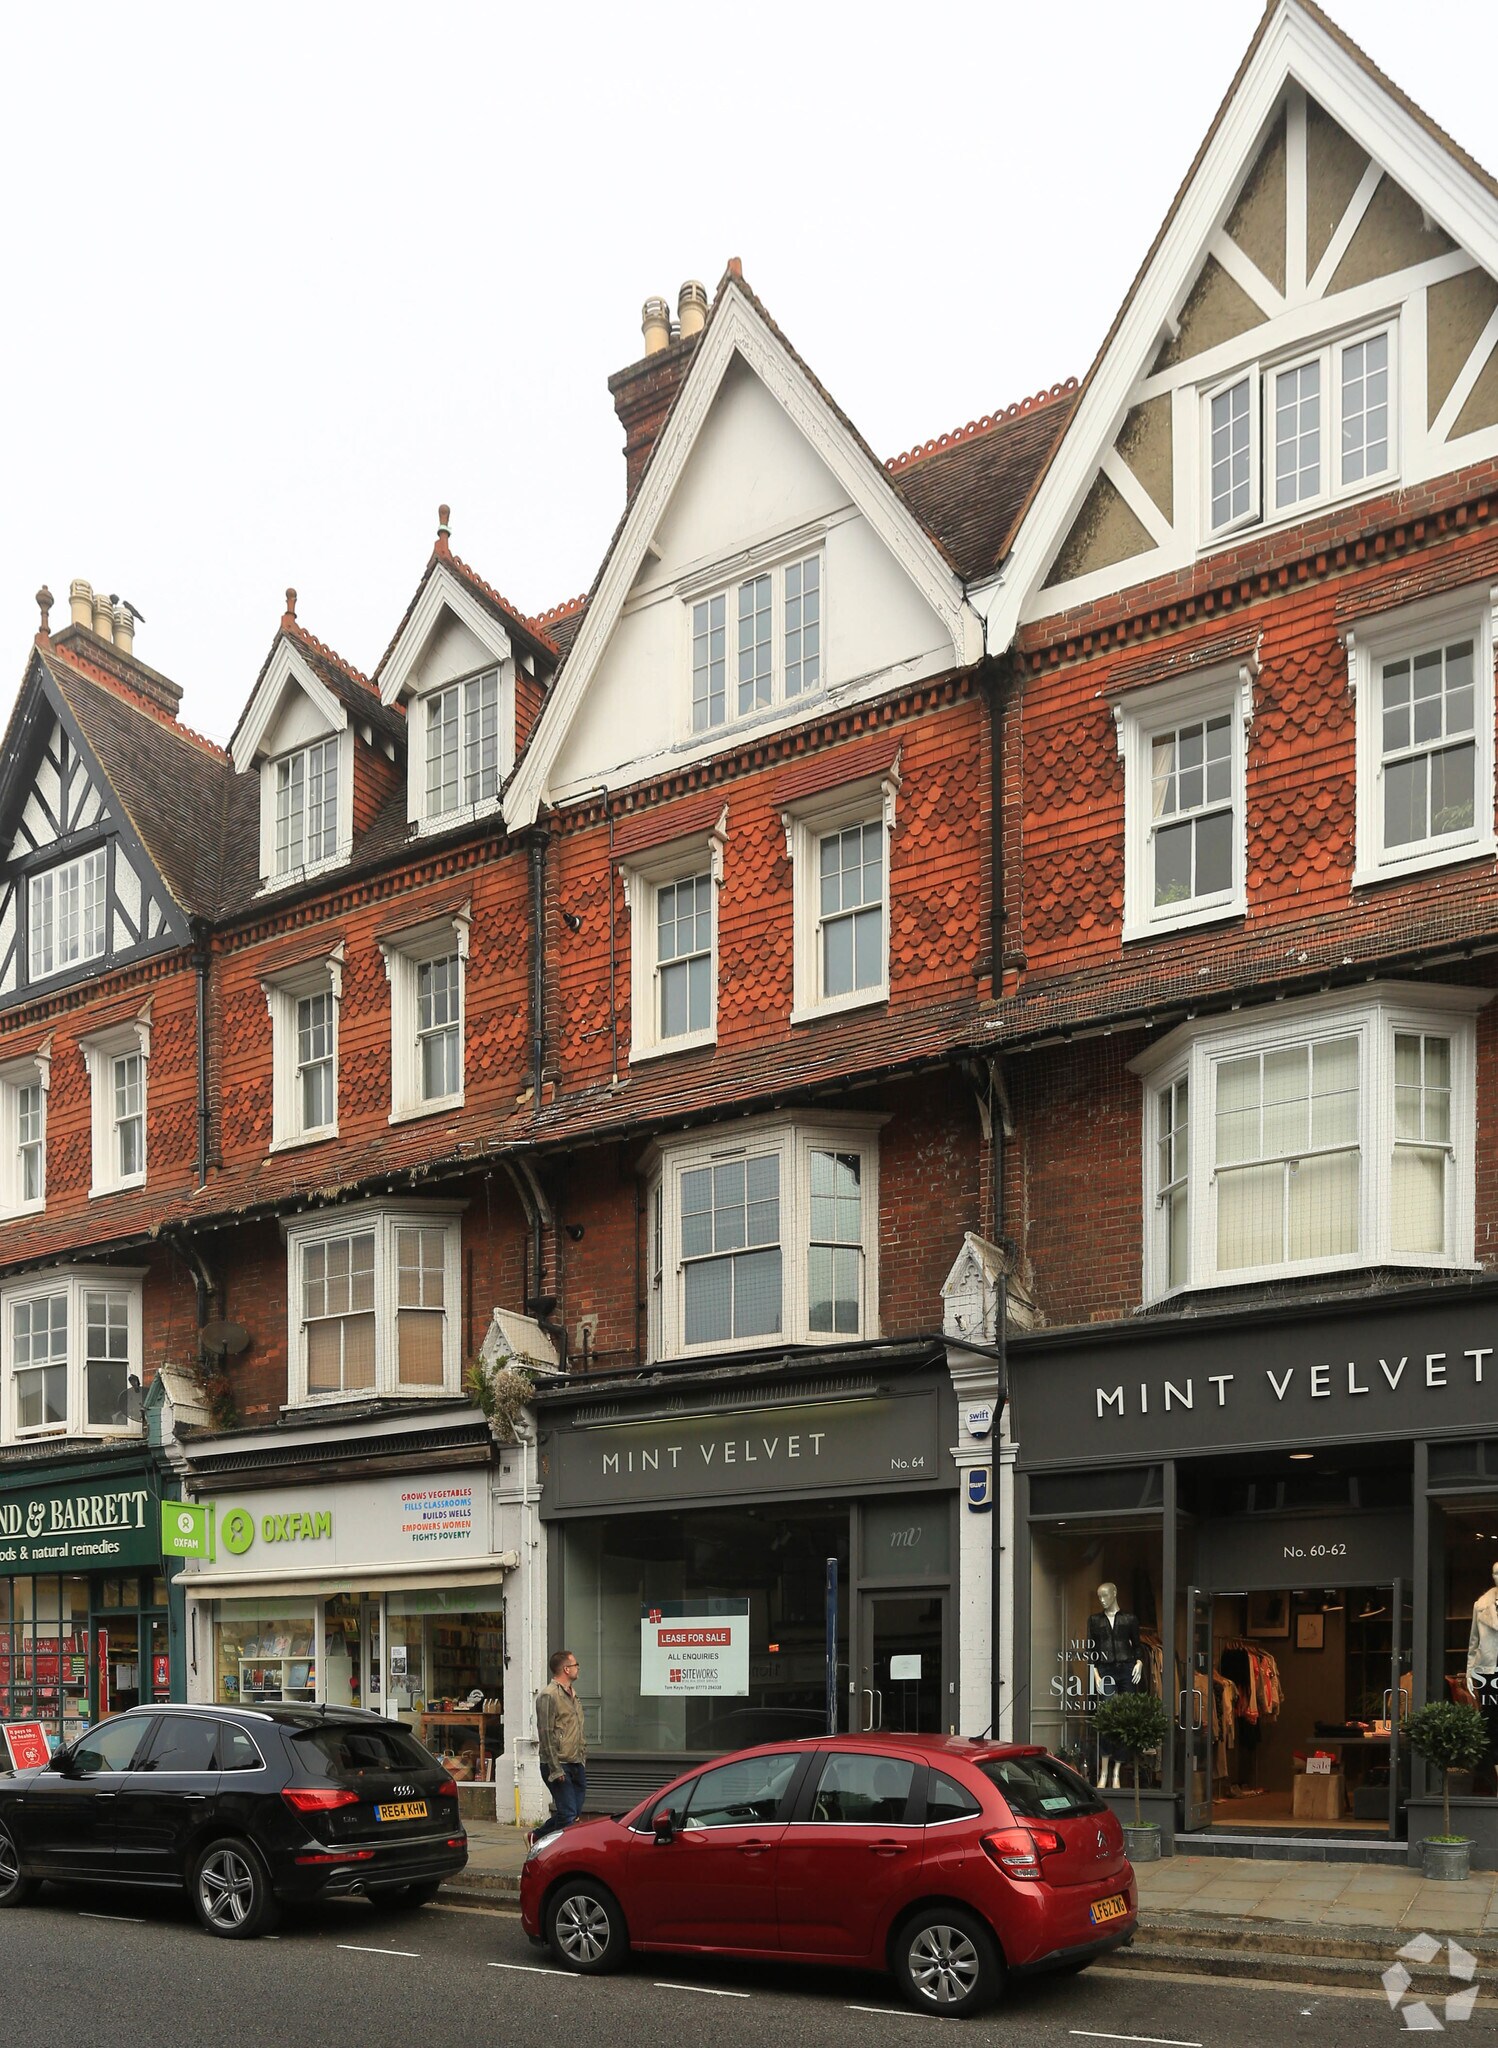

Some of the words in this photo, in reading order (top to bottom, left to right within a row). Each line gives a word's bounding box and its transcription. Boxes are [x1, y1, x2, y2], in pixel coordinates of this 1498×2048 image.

[1096, 1374, 1234, 1418] MINT
[1266, 1348, 1494, 1401] VELVET
[969, 1410, 989, 1420] swift
[602, 1446, 682, 1475] MINT
[700, 1433, 825, 1465] VELVET
[891, 1458, 910, 1470] No.
[911, 1456, 925, 1468] 64
[401, 1491, 427, 1501] GROWS
[428, 1488, 472, 1499] VEGETABLES
[404, 1502, 422, 1511] FILLS
[423, 1498, 472, 1510] CLASSROOMS
[26, 1501, 46, 1539] &
[50, 1490, 149, 1530] BARRETT
[422, 1511, 447, 1520] BUILDS
[448, 1509, 472, 1518] WELLS
[261, 1510, 332, 1544] OXFAM
[402, 1522, 441, 1532] EMPOWERS
[442, 1520, 472, 1530] WOMEN
[412, 1532, 438, 1541] FIGHTS
[438, 1530, 471, 1540] POVERTY
[20, 1546, 29, 1560] &
[32, 1542, 69, 1560] natural
[71, 1539, 121, 1556] remedies
[173, 1537, 199, 1549] OXFAM
[1283, 1546, 1307, 1558] No.
[1310, 1543, 1347, 1557] 60-62
[661, 1633, 687, 1643] LEASE
[687, 1633, 704, 1643] FOR
[705, 1632, 727, 1642] SALE
[1071, 1639, 1096, 1649] MID
[667, 1653, 681, 1661] ALL
[682, 1652, 719, 1660] ENQUIRIES
[1057, 1651, 1108, 1662] SEASON
[681, 1668, 719, 1680] SITEWORKS
[1049, 1663, 1116, 1697] sale
[1060, 1700, 1105, 1711] INSID
[381, 1804, 406, 1818] RE64
[1092, 1901, 1113, 1920] LF62
